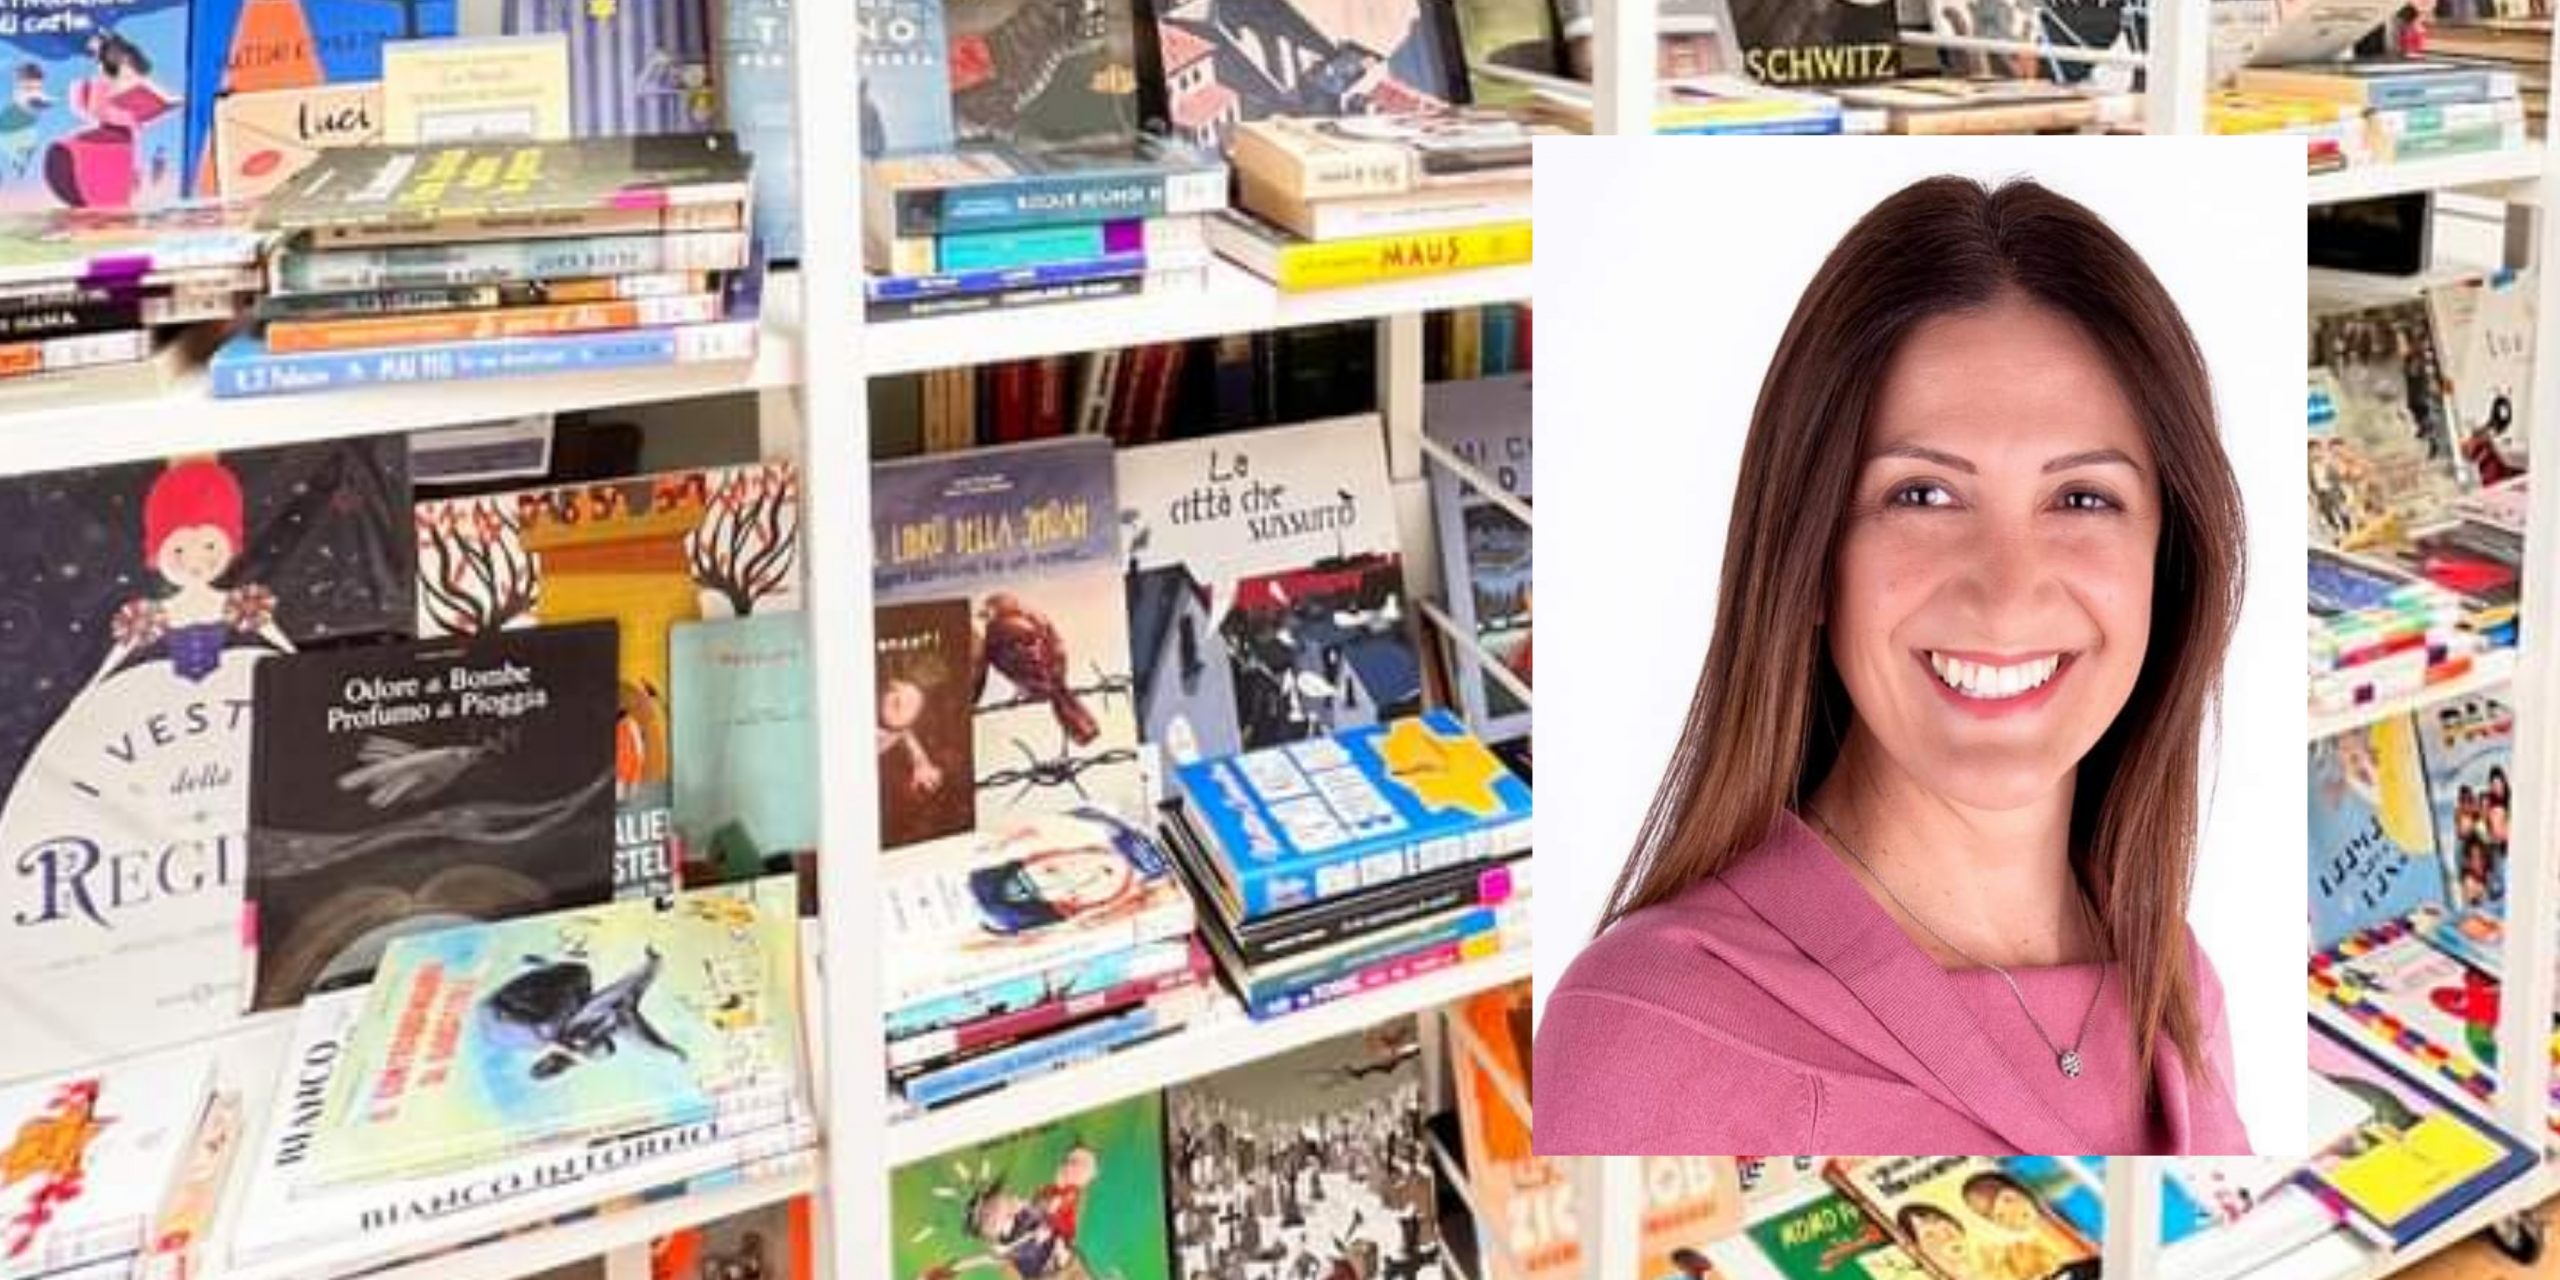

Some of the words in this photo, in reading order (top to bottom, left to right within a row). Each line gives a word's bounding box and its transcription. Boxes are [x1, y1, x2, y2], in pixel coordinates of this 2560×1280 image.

[1745, 44, 1895, 82] SCHWITZ
[1381, 237, 1461, 273] MAUS
[1209, 449, 1249, 482] La
[1240, 480, 1285, 514] che
[345, 677, 420, 703] Odore
[449, 659, 532, 691] Bombe
[327, 702, 431, 734] Profumo
[460, 688, 549, 718] Pioggia
[360, 1169, 524, 1231] BIANCO
